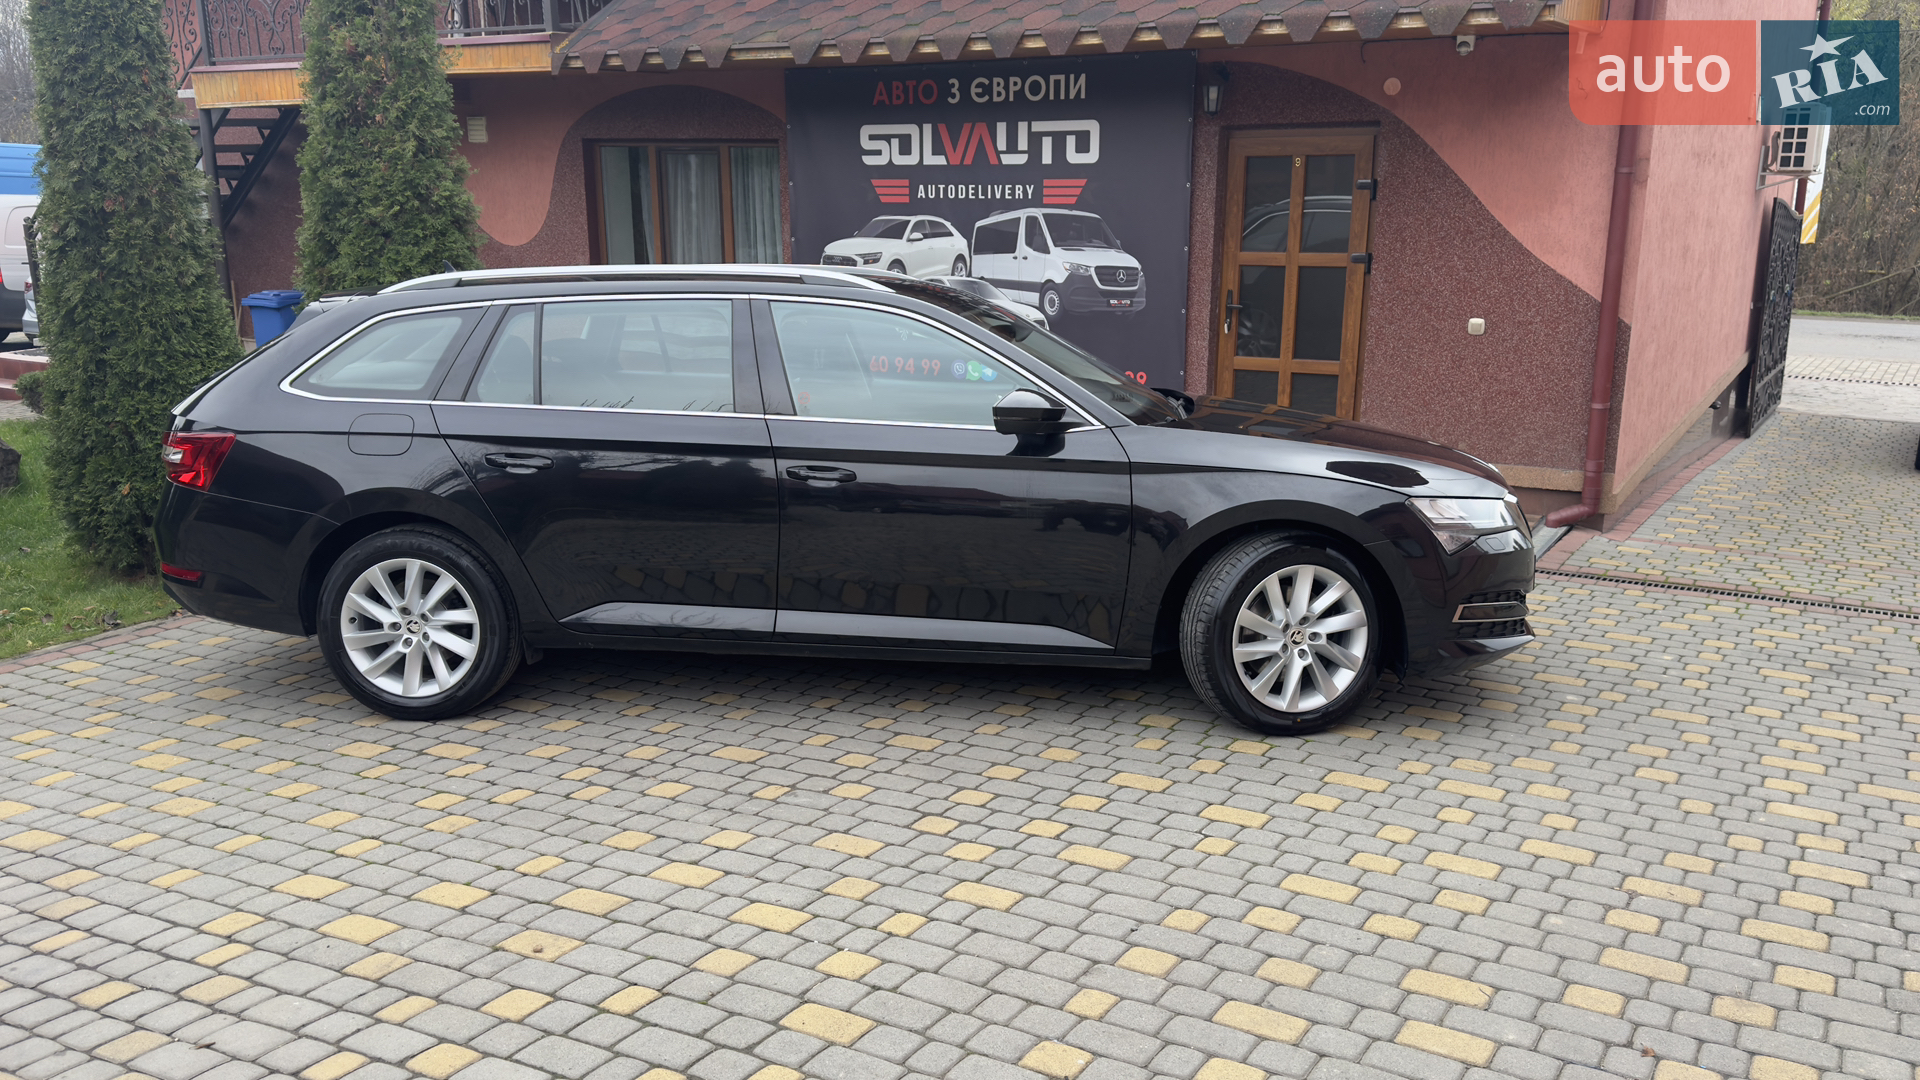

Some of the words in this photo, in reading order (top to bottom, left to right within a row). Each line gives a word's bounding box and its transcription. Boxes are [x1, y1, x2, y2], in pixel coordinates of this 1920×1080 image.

[872, 79, 938, 105] АВТО
[970, 73, 1086, 103] ЄВРОПИ
[860, 119, 1100, 166] SOLVAUTO
[1295, 157, 1301, 167] 9
[917, 184, 1035, 199] AUTODELIVERY
[869, 355, 889, 373] 60
[895, 357, 915, 375] 94
[921, 358, 941, 376] 99
[1125, 371, 1147, 385] 9
